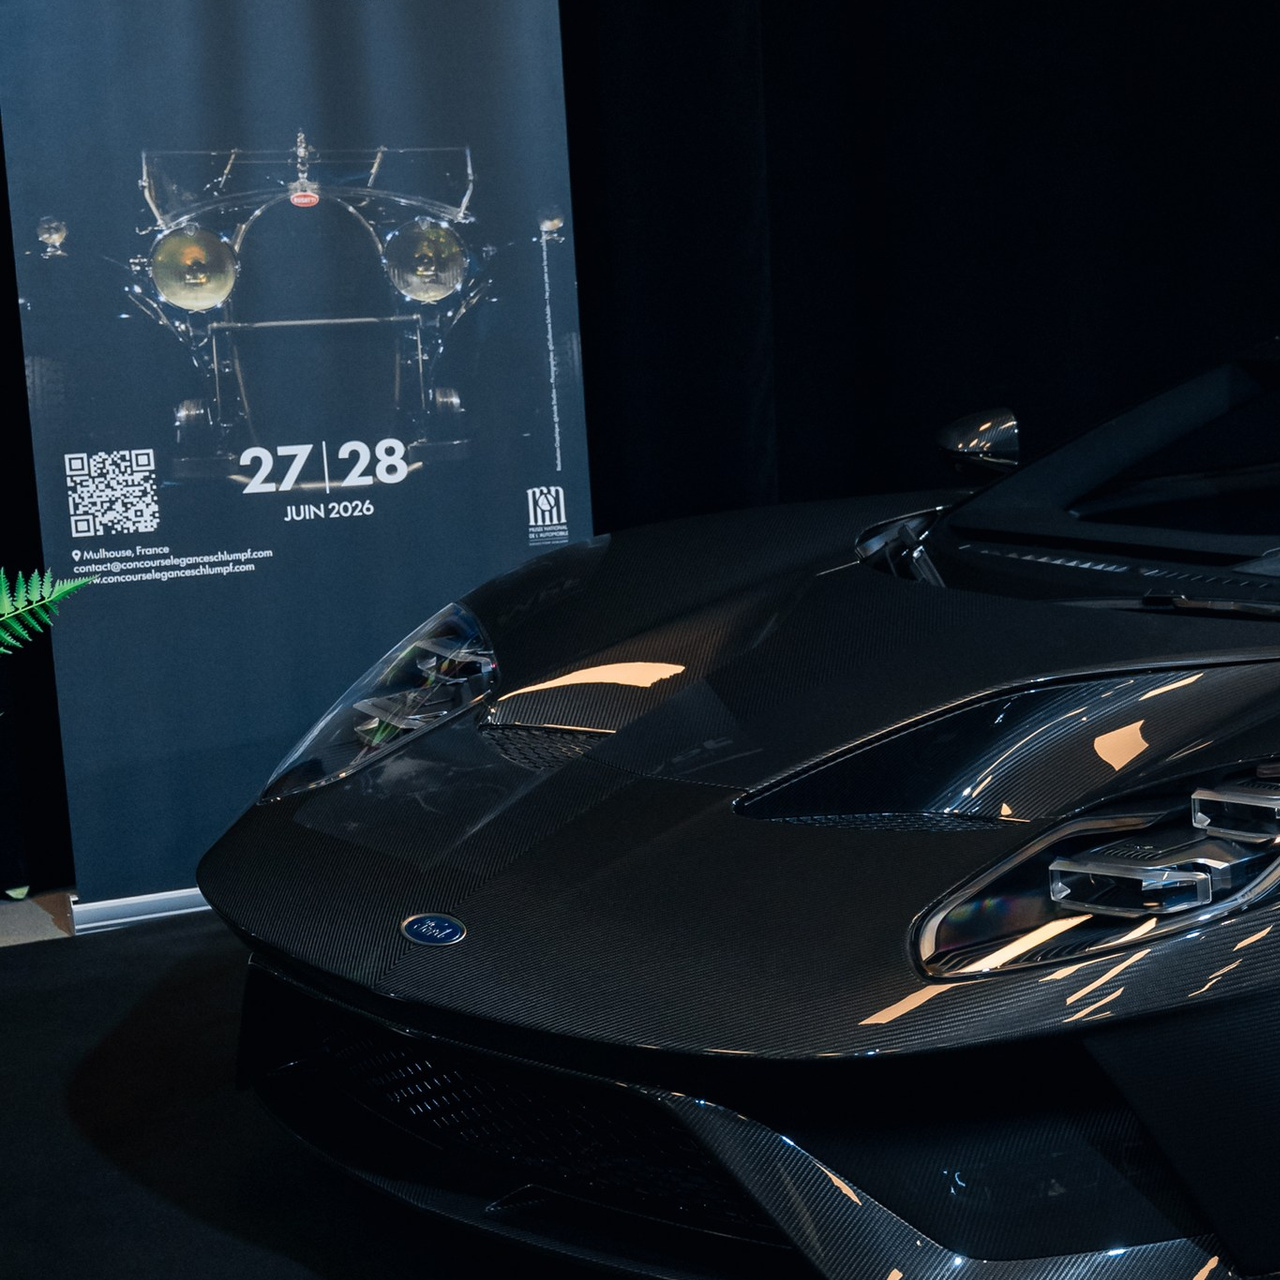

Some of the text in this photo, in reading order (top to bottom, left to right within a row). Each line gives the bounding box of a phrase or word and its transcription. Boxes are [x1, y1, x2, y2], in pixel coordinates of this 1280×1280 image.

[239, 438, 410, 495] 27 28
[284, 499, 375, 522] JUIN 2026
[73, 548, 273, 574] contact@concourseleganceschlumpf.com
[83, 545, 170, 561] Mulhouse, France
